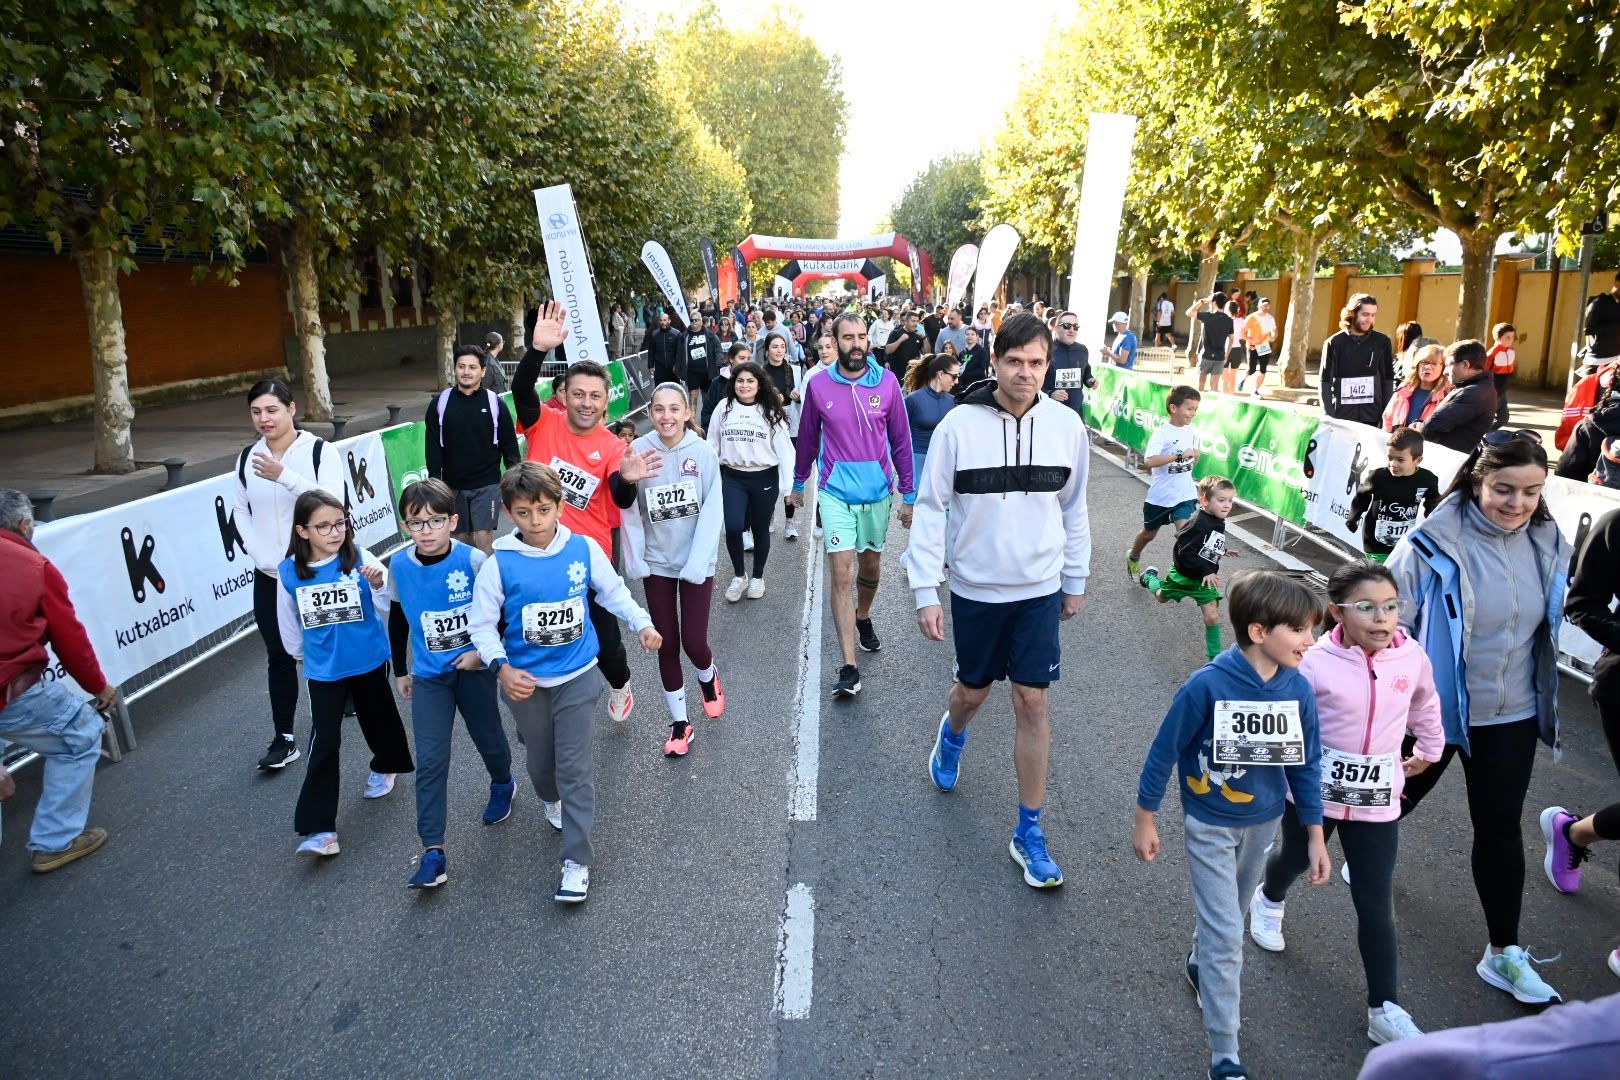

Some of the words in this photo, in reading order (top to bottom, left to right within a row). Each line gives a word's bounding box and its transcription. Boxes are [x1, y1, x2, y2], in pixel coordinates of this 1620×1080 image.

[803, 260, 860, 270] kutxabank
[1349, 384, 1366, 395] 1412
[557, 467, 588, 492] 5378
[656, 488, 687, 506] 3272
[351, 502, 392, 532] kutxabank
[212, 567, 254, 601] kutxab
[568, 585, 588, 595] AMPA
[311, 588, 349, 607] 3275
[448, 590, 472, 601] AMPA
[115, 596, 195, 649] kutxabank
[434, 612, 469, 634] 3271
[537, 607, 574, 628] 3279
[1231, 712, 1288, 735] 3600
[1330, 760, 1380, 783] 3574
